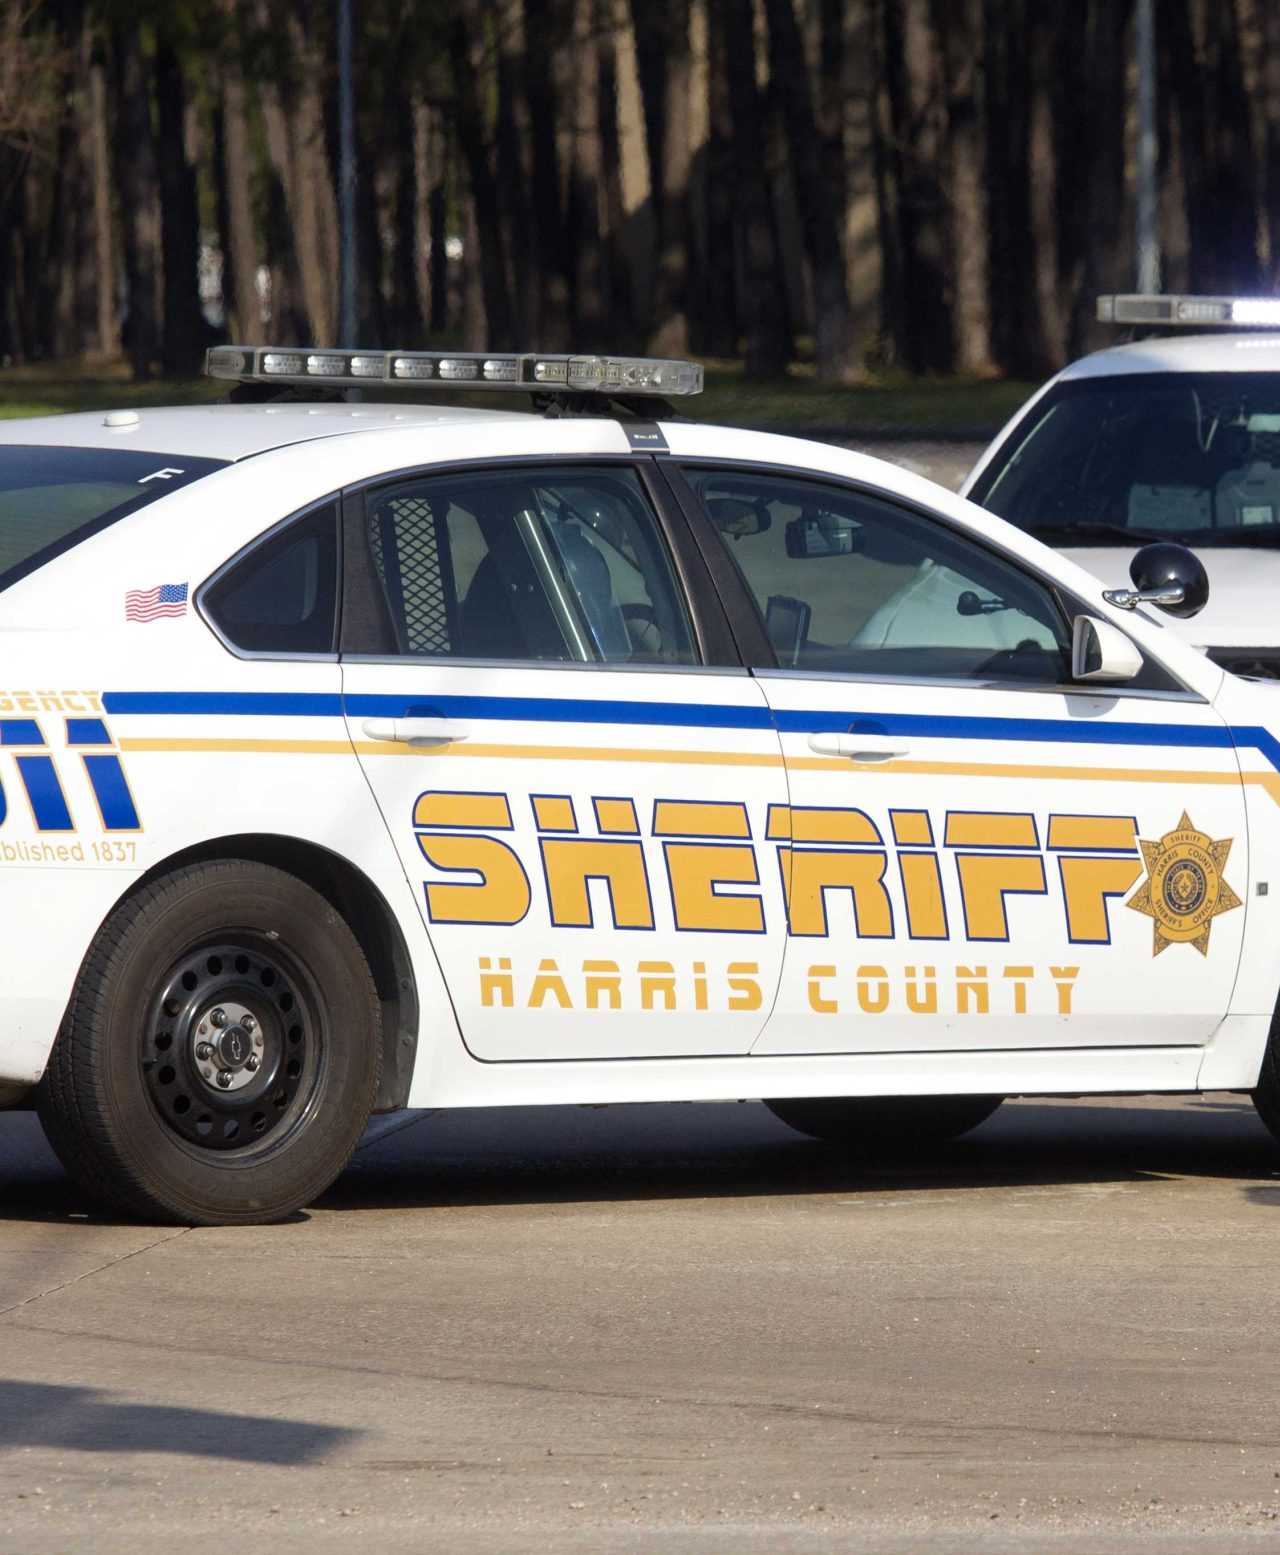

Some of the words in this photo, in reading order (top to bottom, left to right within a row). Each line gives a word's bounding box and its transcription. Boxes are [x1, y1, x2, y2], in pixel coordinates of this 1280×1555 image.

[0, 839, 85, 862] blished
[91, 841, 137, 862] 1837
[1169, 833, 1201, 844] SHERIFF
[412, 789, 1143, 945] SHERIFF
[1187, 848, 1214, 875] COUNTY
[478, 956, 764, 1012] HARRIS
[806, 964, 1081, 1015] COUNTY
